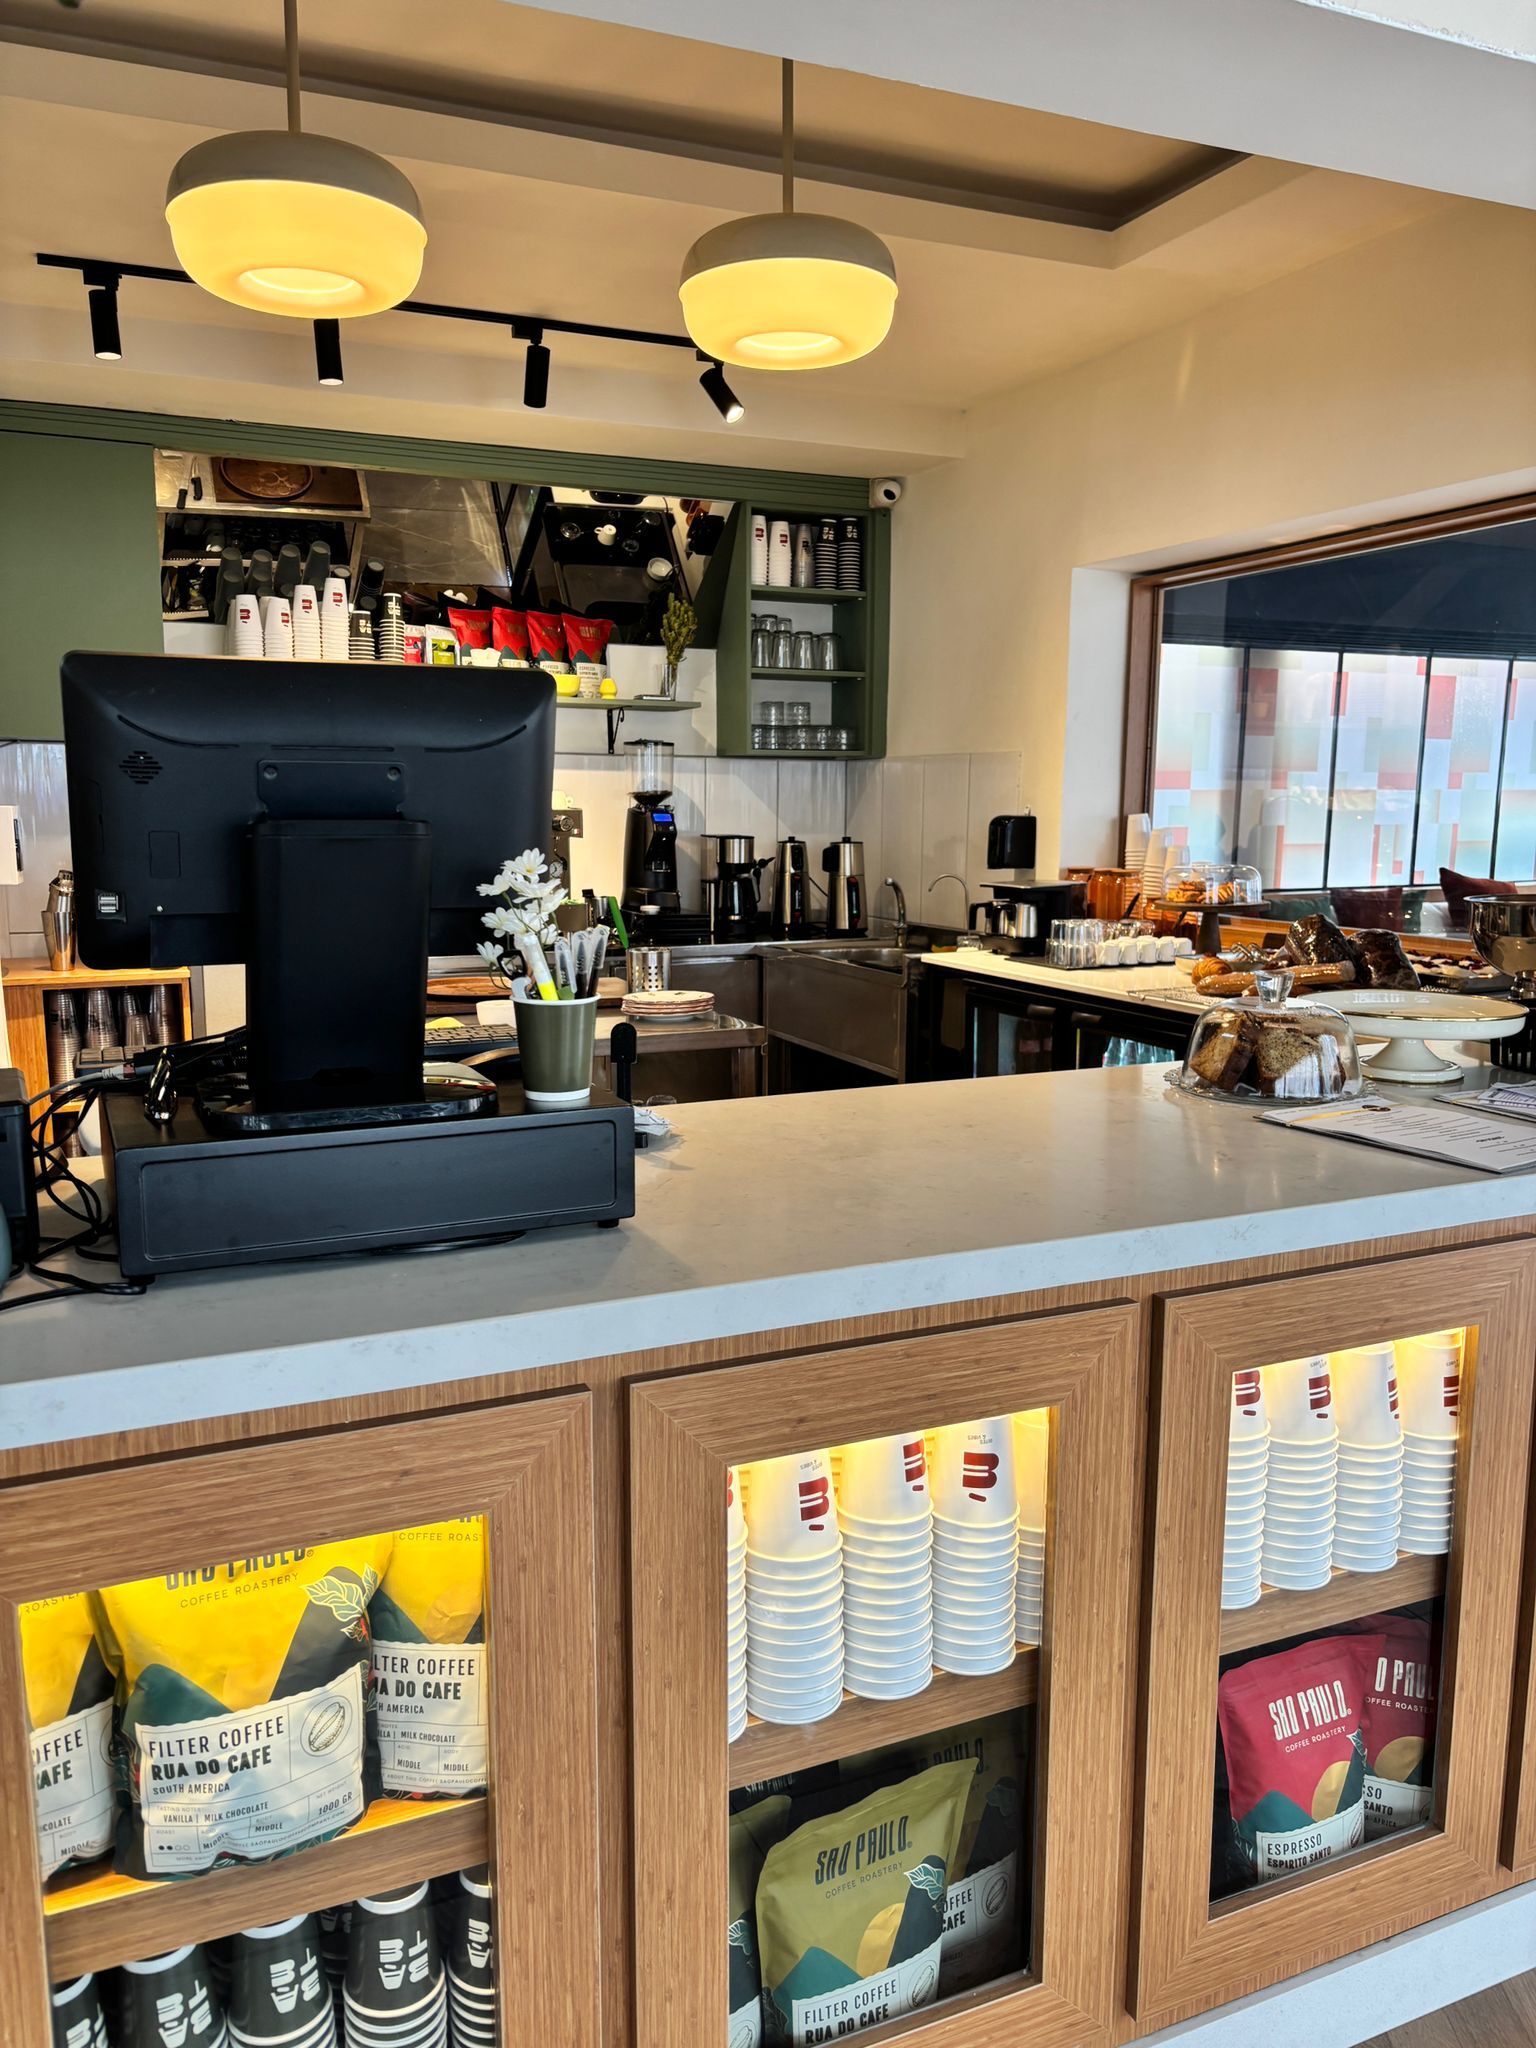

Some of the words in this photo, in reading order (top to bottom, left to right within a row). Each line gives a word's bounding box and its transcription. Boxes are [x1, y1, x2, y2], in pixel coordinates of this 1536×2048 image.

[398, 1532, 443, 1541] COFFEE
[180, 1589, 229, 1608] COFFEE
[235, 1572, 299, 1596] ROASTERY
[373, 1654, 409, 1674] LTER
[417, 1658, 475, 1676] COFFEE
[395, 1679, 416, 1698] DO
[422, 1681, 462, 1700] CAFE
[386, 1705, 425, 1714] AMERICA
[1296, 1679, 1348, 1732] PAULO
[149, 1736, 209, 1759] FILTER
[218, 1715, 285, 1750] COFFEE
[400, 1730, 418, 1740] MILK
[418, 1732, 456, 1744] CHOCOLATE
[1284, 1738, 1310, 1753] COFFEE
[1311, 1725, 1346, 1743] ROASTERY
[151, 1762, 189, 1781] RUA
[195, 1758, 220, 1775] DO
[227, 1745, 272, 1774] CAFE
[397, 1758, 421, 1770] MIDDLE
[443, 1763, 469, 1772] MIDDLE
[152, 1783, 185, 1796] SOUTH
[187, 1782, 231, 1795] AMERICA
[163, 1814, 193, 1824] VANILLA
[204, 1811, 224, 1824] MILK
[225, 1801, 269, 1820] CHOCOLATE
[318, 1799, 340, 1816] 1000
[342, 1791, 353, 1806] GR
[254, 1822, 284, 1833] MIDDLE
[815, 1840, 852, 1886] SAO
[855, 1815, 910, 1871] PAULO
[1267, 1832, 1322, 1856] ESPRESSO
[1267, 1856, 1308, 1870] ESPIRITO
[1309, 1846, 1332, 1865] SANTO
[824, 1879, 857, 1900] COFFEE
[860, 1860, 904, 1884] ROASTERY
[942, 1888, 973, 1915] OFFEE
[804, 2000, 849, 2025] FILTER
[854, 1979, 897, 2009] COFFEE
[805, 2025, 833, 2045] RUA
[838, 2016, 855, 2036] DO
[859, 2002, 890, 2028] CAFE
